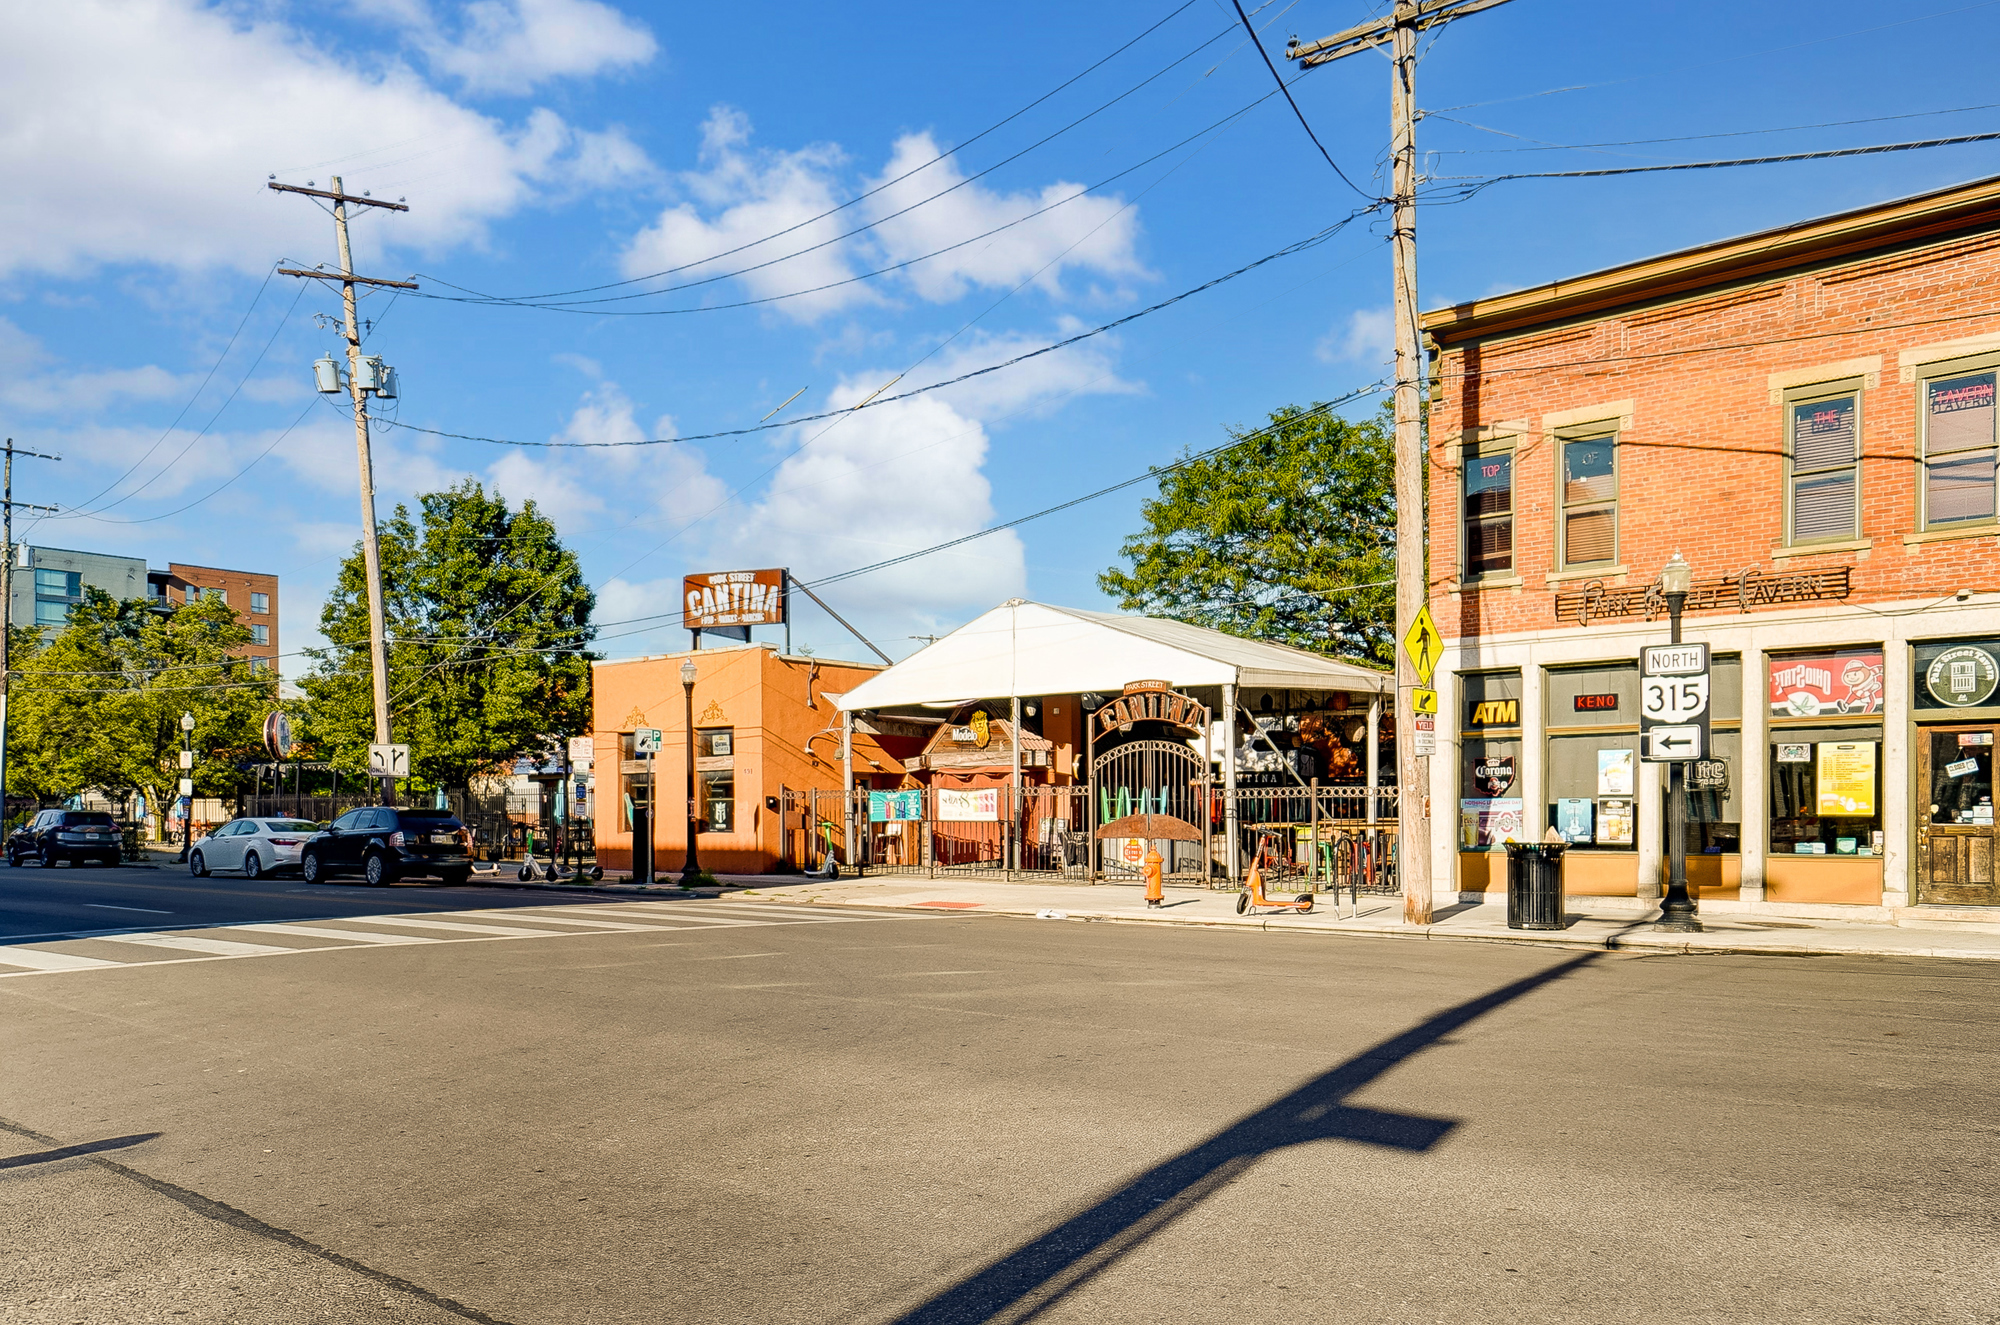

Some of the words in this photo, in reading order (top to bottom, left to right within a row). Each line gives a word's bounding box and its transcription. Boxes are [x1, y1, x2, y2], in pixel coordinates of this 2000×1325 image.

[1481, 464, 1500, 477] TOP
[1582, 452, 1598, 465] OF
[1814, 409, 1838, 424] THE
[1936, 384, 1994, 404] TAVERN
[728, 572, 756, 583] STREET
[687, 582, 779, 617] CANTINA
[1652, 652, 1698, 668] NORTH
[1125, 683, 1141, 691] PARK
[1141, 681, 1165, 689] STREET
[1577, 695, 1615, 708] KENO
[1647, 683, 1701, 712] 315
[1100, 692, 1202, 731] CANTINA
[1472, 701, 1517, 723] ATM
[1417, 721, 1434, 730] YIELD
[653, 730, 660, 741] P
[952, 727, 978, 741] Modelo
[1236, 774, 1277, 783] NTINA
[1475, 765, 1513, 779] Corona
[1684, 761, 1725, 784] Lite
[1839, 796, 1857, 811] $6
